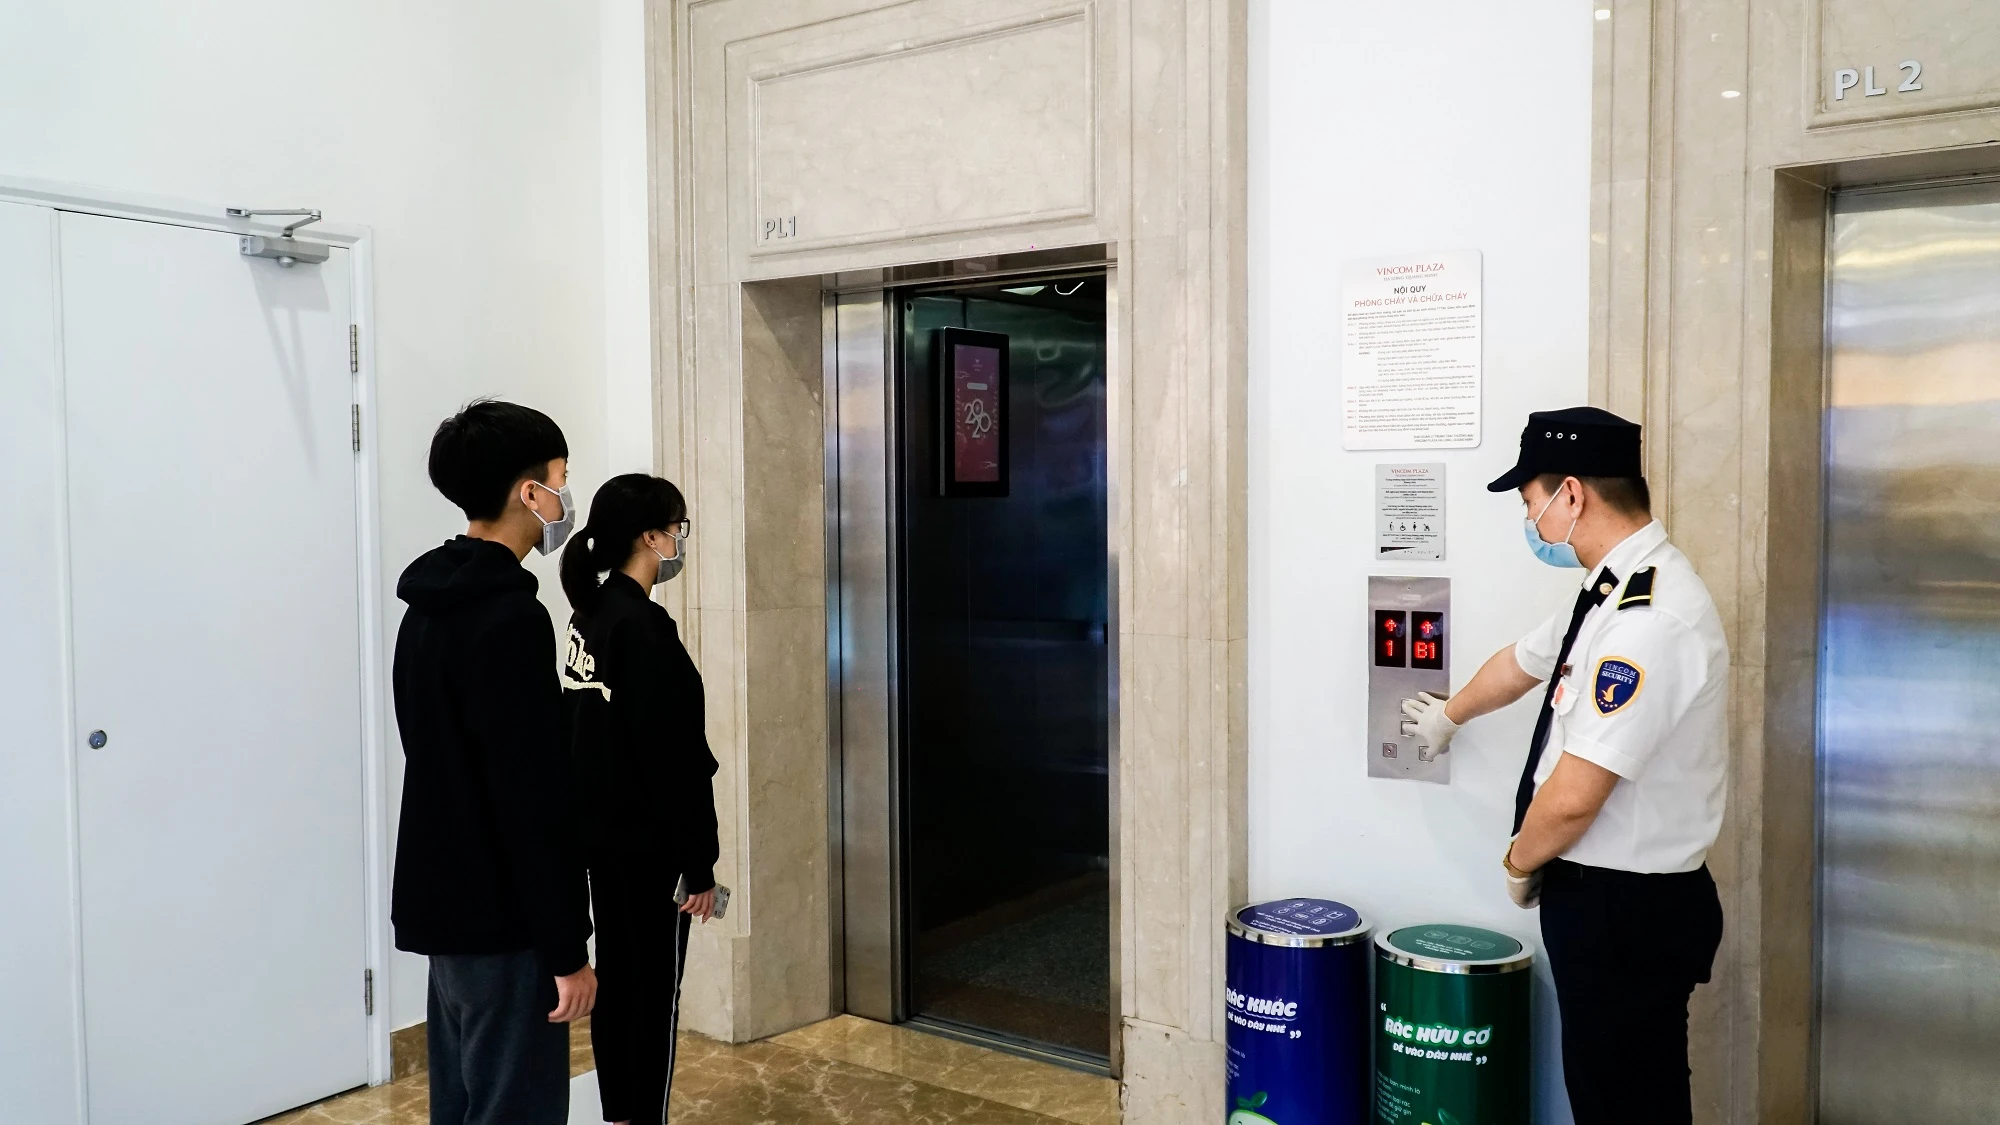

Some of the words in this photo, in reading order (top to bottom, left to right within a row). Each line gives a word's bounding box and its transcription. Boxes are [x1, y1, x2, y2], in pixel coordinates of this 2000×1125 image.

[1835, 66, 1887, 101] PL
[1898, 60, 1922, 92] 2
[764, 215, 796, 240] PL1
[1377, 265, 1413, 276] VINCOM
[1416, 263, 1445, 272] PLAZA
[1354, 298, 1383, 307] PHÒNG
[1384, 296, 1406, 306] CHÁY
[1408, 294, 1419, 303] VÀ
[1420, 292, 1443, 302] CHỮA
[1445, 290, 1468, 301] CHÁY
[1394, 284, 1408, 295] NỘI
[1410, 285, 1427, 293] QUY
[1385, 640, 1393, 657] 1
[1414, 641, 1436, 659] B1
[1601, 670, 1634, 684] SECURITY
[1604, 662, 1637, 677] VINCOM
[1247, 998, 1298, 1017] KHÁC
[1385, 1018, 1413, 1039] RÁC
[1416, 1025, 1460, 1045] HỮU
[1462, 1027, 1491, 1045] CƠ
